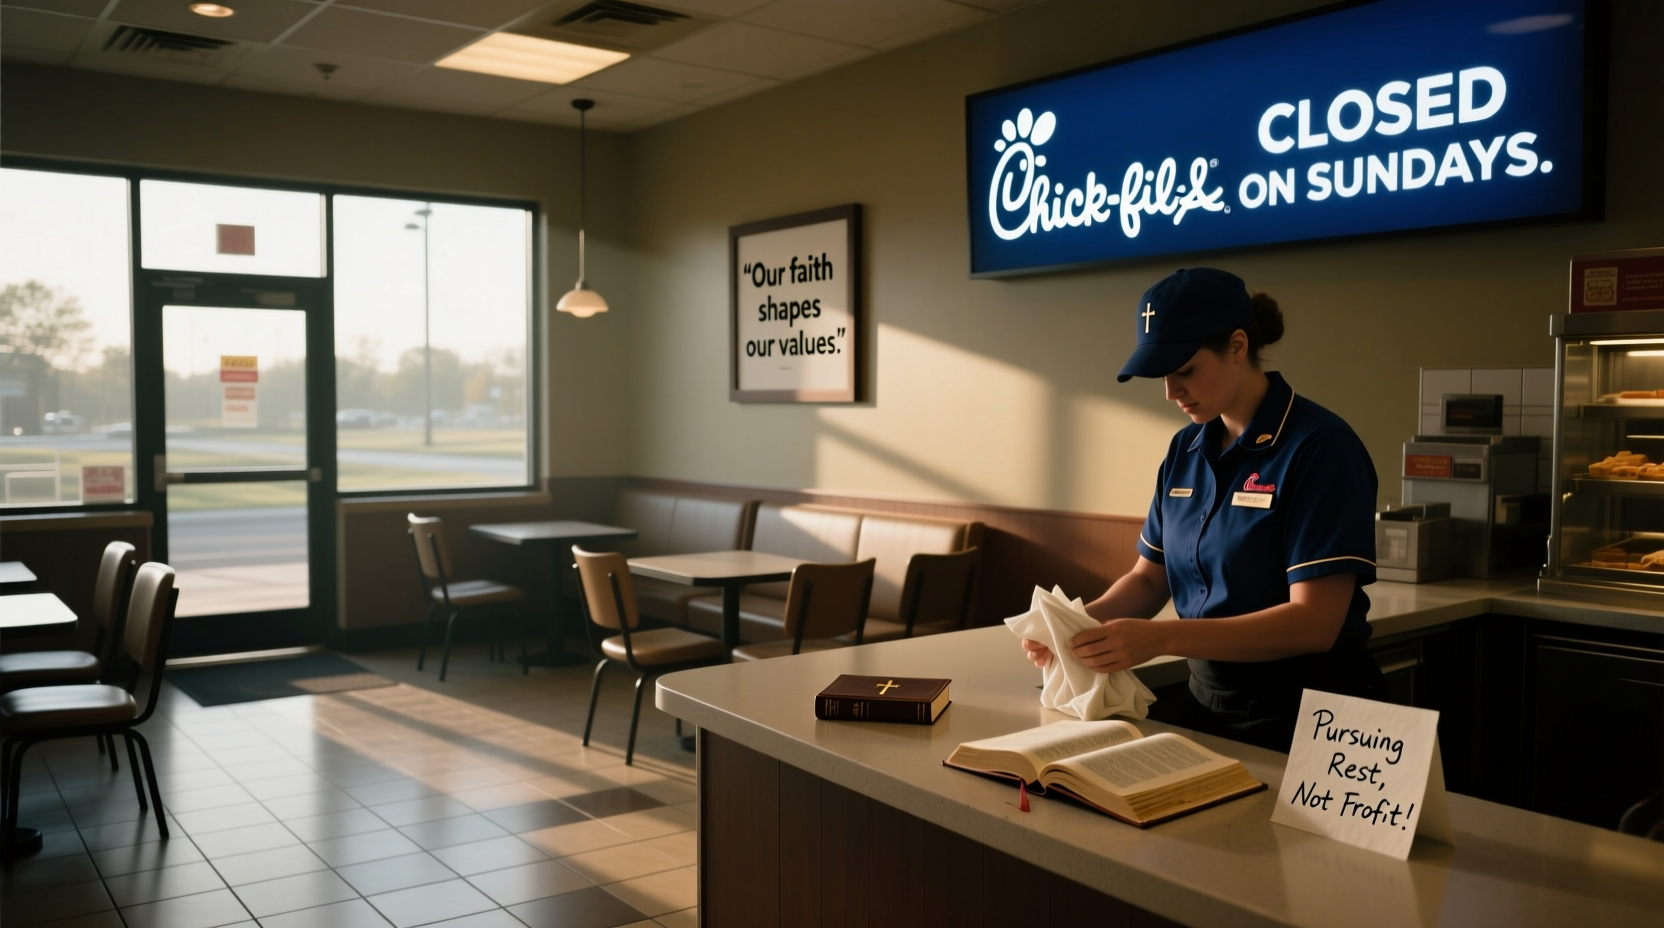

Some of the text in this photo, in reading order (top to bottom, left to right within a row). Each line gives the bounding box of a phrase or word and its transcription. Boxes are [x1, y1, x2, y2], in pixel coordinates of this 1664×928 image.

[1257, 65, 1507, 155] CLOSED
[1238, 131, 1553, 209] ON SUNDAYS.
[743, 252, 834, 288] “Our faith
[758, 294, 822, 328] shapes
[746, 327, 846, 357] our values.”
[1312, 709, 1404, 765] Pursuing
[1327, 752, 1386, 792] Rest,
[1291, 780, 1334, 811] Not
